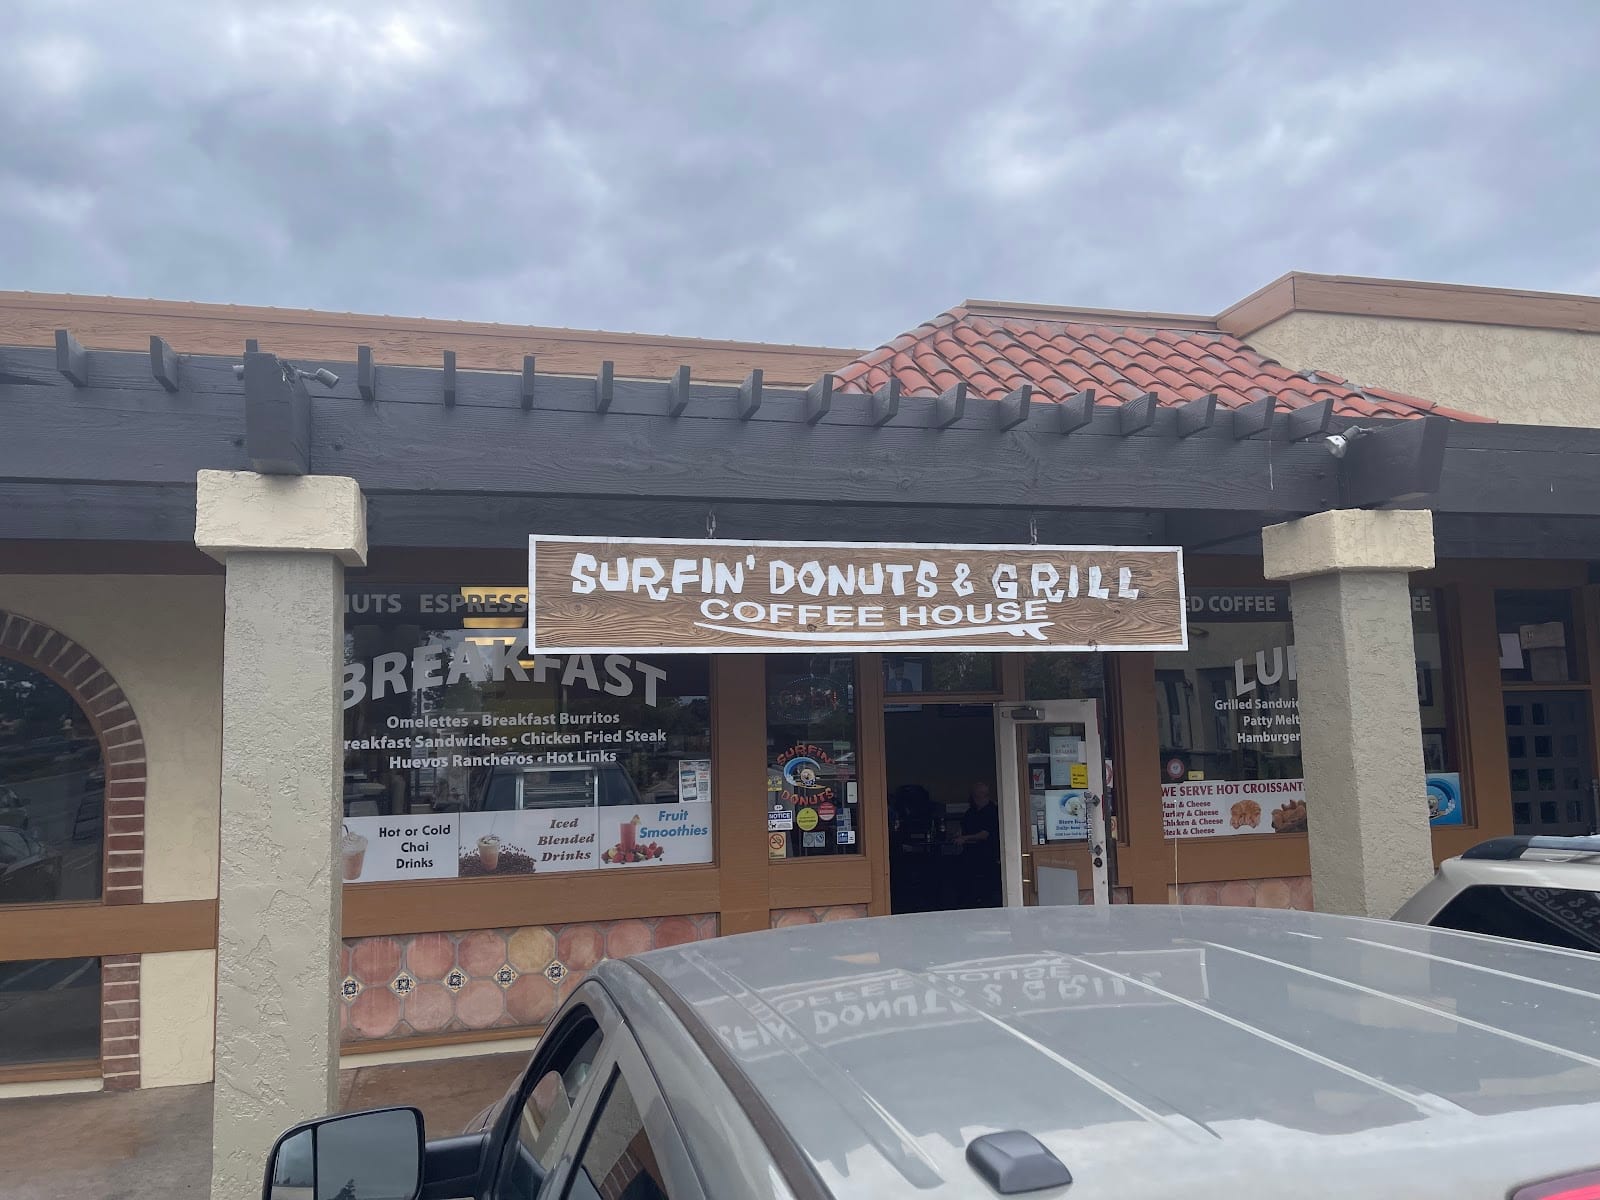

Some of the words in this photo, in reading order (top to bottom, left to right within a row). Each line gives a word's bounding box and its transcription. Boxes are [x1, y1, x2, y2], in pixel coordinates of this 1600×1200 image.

[571, 552, 756, 601] SURFIN'
[769, 559, 939, 598] DONUTS
[951, 562, 975, 597] &
[991, 562, 1140, 603] GRILL
[344, 594, 402, 613] UTS
[1209, 596, 1276, 612] COFFEE
[700, 599, 885, 626] COFFEE
[899, 599, 1049, 626] HOUSE
[344, 639, 667, 710] BREAKFAST
[1215, 699, 1252, 710] Grilled
[386, 715, 469, 729] Omelettes
[481, 712, 556, 727] Breakfast
[559, 711, 620, 725] Burritos
[1243, 716, 1273, 728] Patty
[415, 733, 508, 749] Sandwiches
[520, 731, 581, 746] Chicken
[584, 729, 622, 744] Fried
[625, 729, 667, 743] Steak
[389, 755, 449, 769] Huevos
[452, 753, 534, 767] Rancheros
[546, 751, 574, 764] Hot
[577, 750, 617, 763] Links
[781, 787, 834, 806] DONUTS
[1161, 786, 1176, 797] WE
[1179, 785, 1214, 797] SERVE
[1216, 784, 1240, 795] HOT
[1163, 801, 1177, 809] an
[1186, 800, 1211, 808] Cheese
[658, 809, 689, 822] Fruit
[769, 812, 791, 820] NOTICE
[1194, 809, 1219, 817] Cheese
[550, 818, 579, 829] Iced
[1191, 818, 1198, 826] &
[1199, 818, 1224, 826] Cheese
[379, 827, 401, 838] Hot
[404, 827, 419, 837] or
[422, 824, 451, 836] Cold
[639, 824, 709, 839] Smoothies
[1164, 828, 1181, 836] teak
[1190, 827, 1215, 835] Cheese
[537, 833, 595, 846] Blended
[401, 841, 429, 852] Chai
[541, 850, 592, 862] Drinks
[396, 858, 434, 869] Drinks
